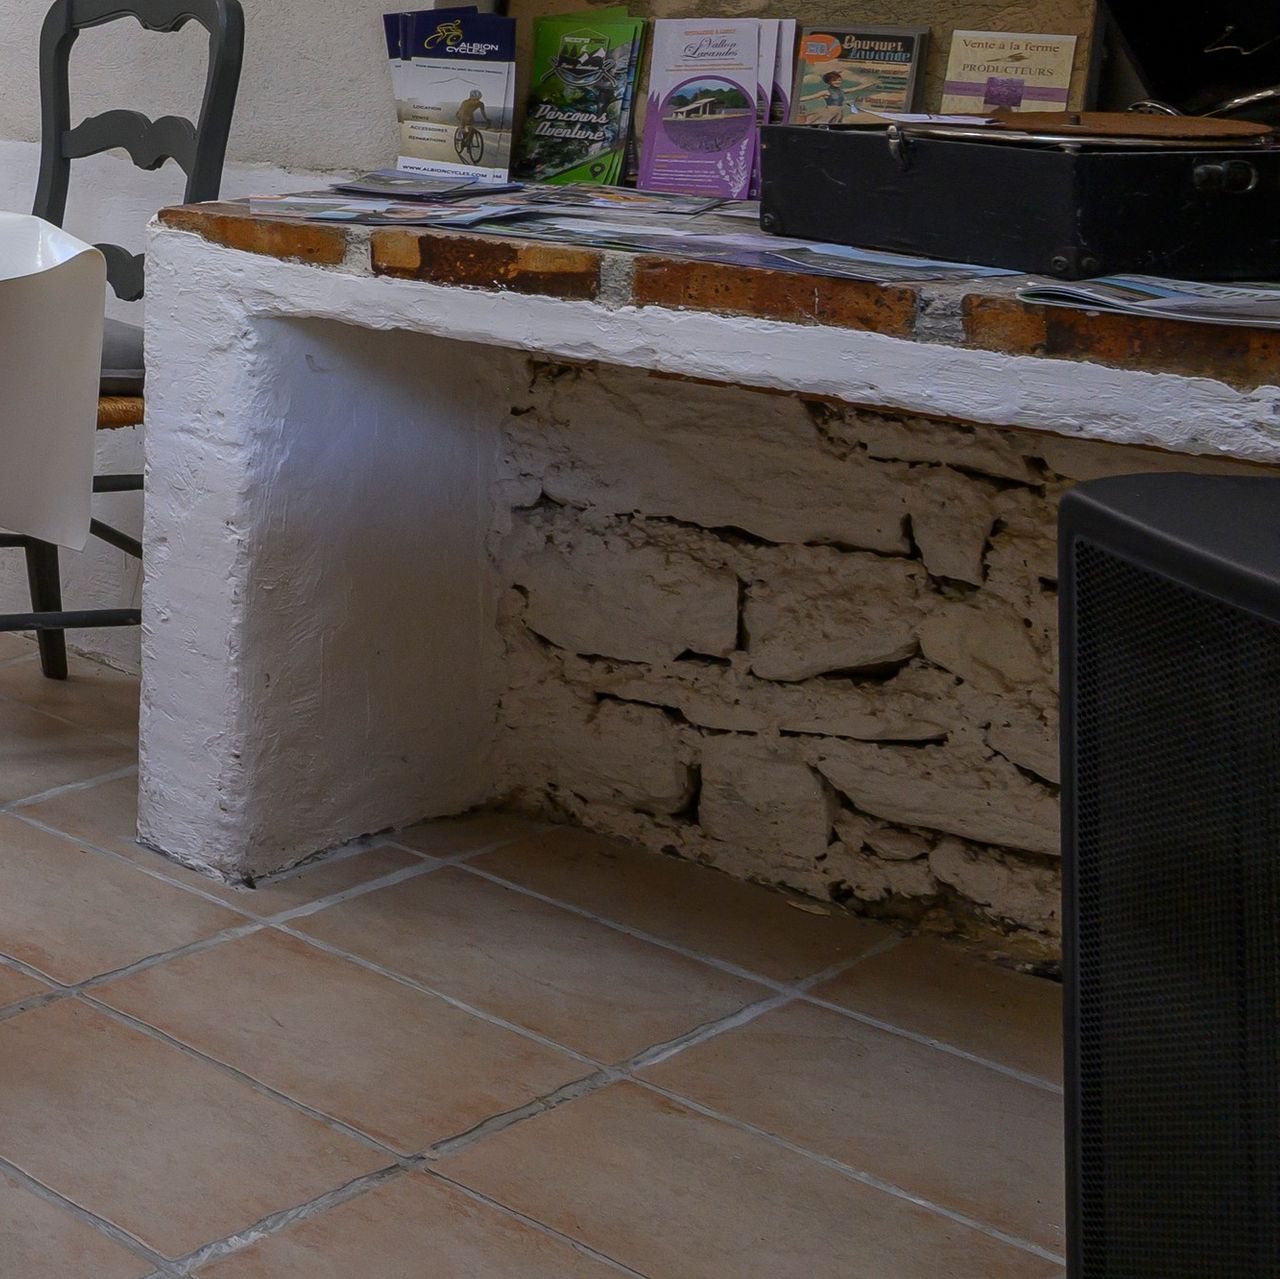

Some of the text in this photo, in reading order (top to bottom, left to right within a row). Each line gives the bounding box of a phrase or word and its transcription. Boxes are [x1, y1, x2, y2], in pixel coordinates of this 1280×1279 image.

[459, 42, 499, 52] ALBION
[842, 34, 905, 52] Bouquet
[962, 39, 996, 49] Vente
[1009, 41, 1020, 51] la
[1024, 42, 1060, 53] ferme
[446, 46, 487, 56] CYCLES
[962, 63, 1055, 77] PRODUCTEURS
[413, 104, 442, 112] LOCATION
[535, 103, 609, 124] Parcours
[535, 121, 605, 140] Aventure
